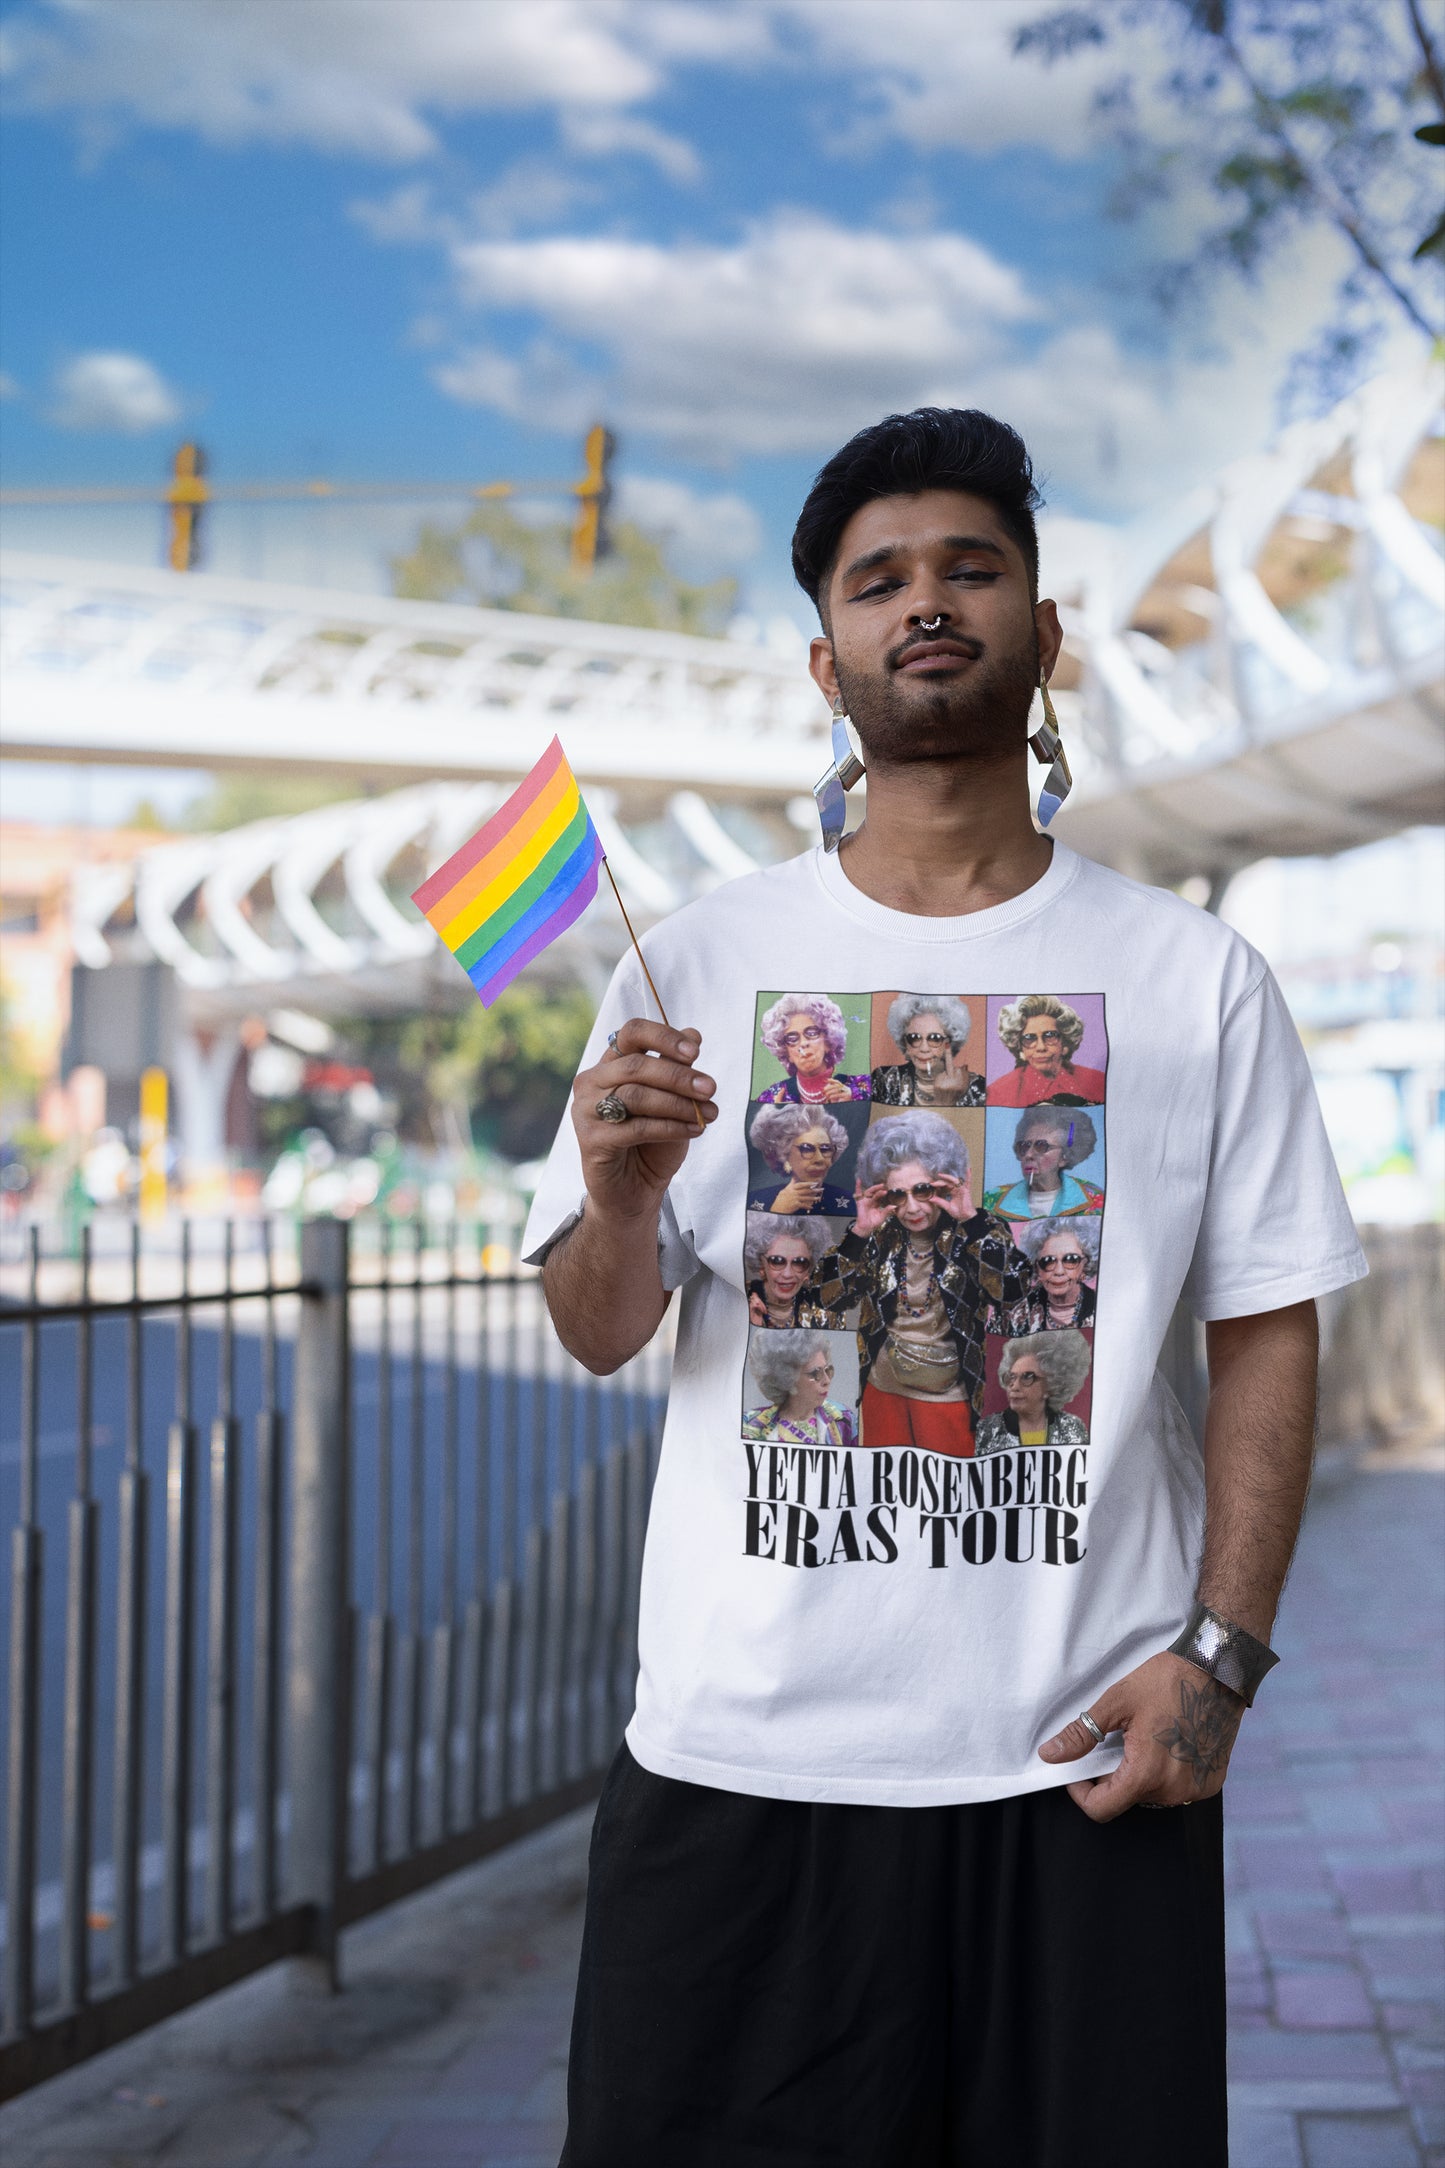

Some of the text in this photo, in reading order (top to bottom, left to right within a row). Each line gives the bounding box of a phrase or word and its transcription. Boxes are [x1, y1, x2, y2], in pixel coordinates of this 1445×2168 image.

[743, 1443, 1088, 1515] YETTA ROSENBERG
[742, 1500, 1087, 1569] ERAS TOUR
